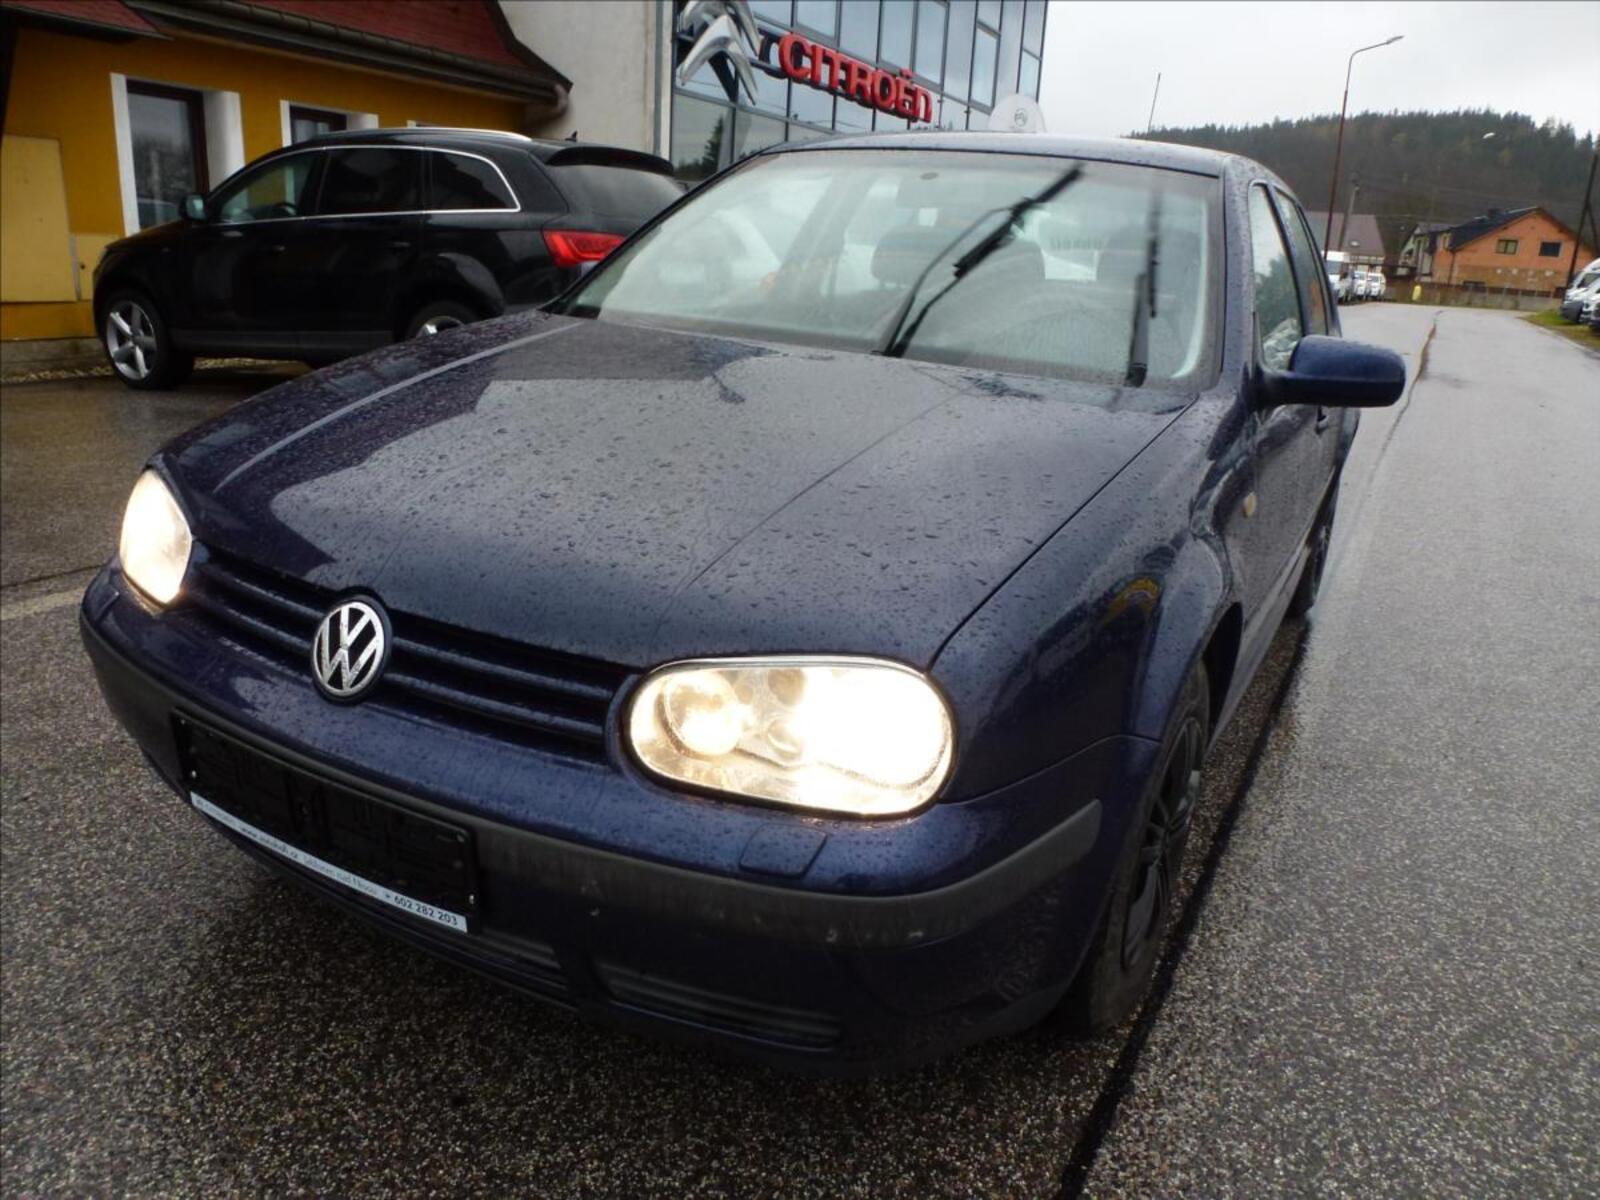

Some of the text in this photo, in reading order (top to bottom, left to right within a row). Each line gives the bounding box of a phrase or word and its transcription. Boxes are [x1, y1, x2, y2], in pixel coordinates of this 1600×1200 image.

[394, 895, 458, 926] 602 282 203
